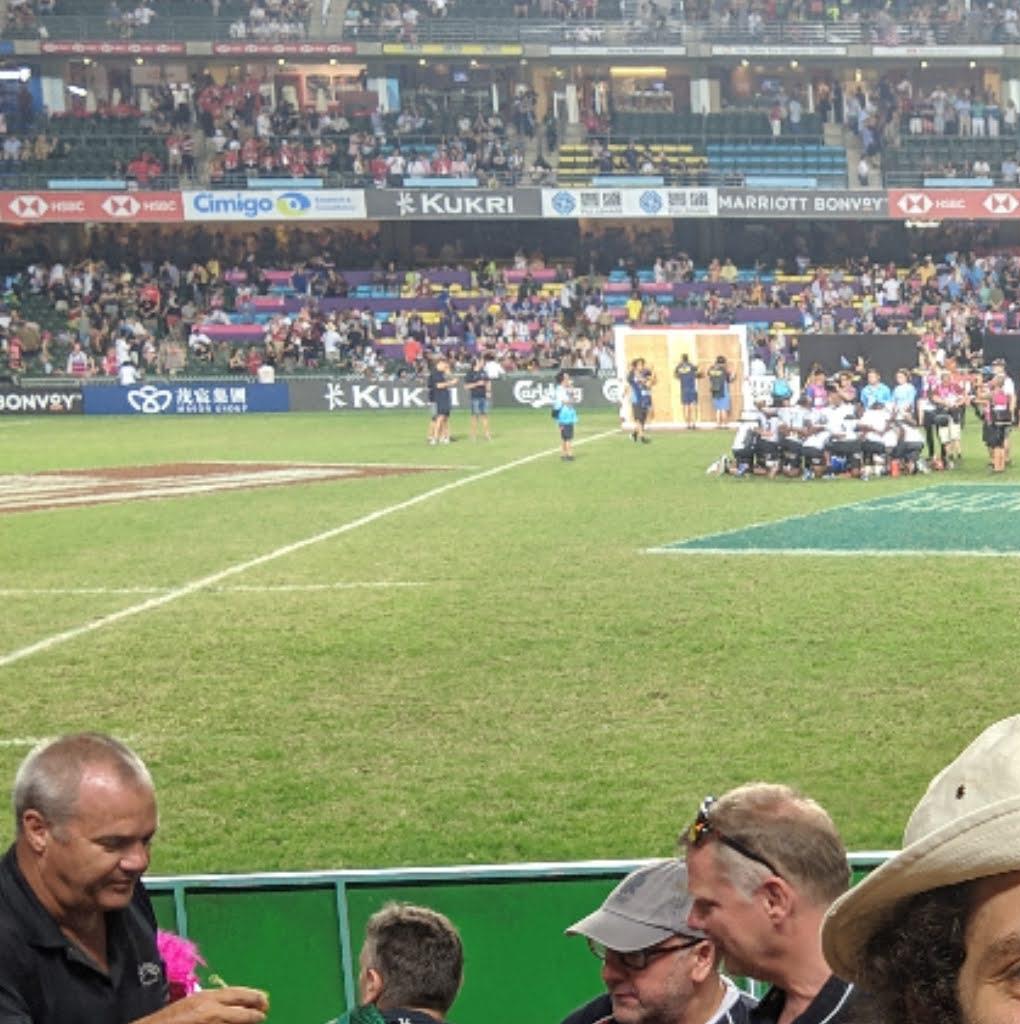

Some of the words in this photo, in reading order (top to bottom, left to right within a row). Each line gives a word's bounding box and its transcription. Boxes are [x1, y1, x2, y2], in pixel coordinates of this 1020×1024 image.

[193, 192, 272, 217] Cimigo
[421, 193, 514, 213] KUKRI
[719, 195, 807, 211] MARRIOTT
[814, 197, 882, 212] BONVOY
[352, 385, 460, 408] KUKI
